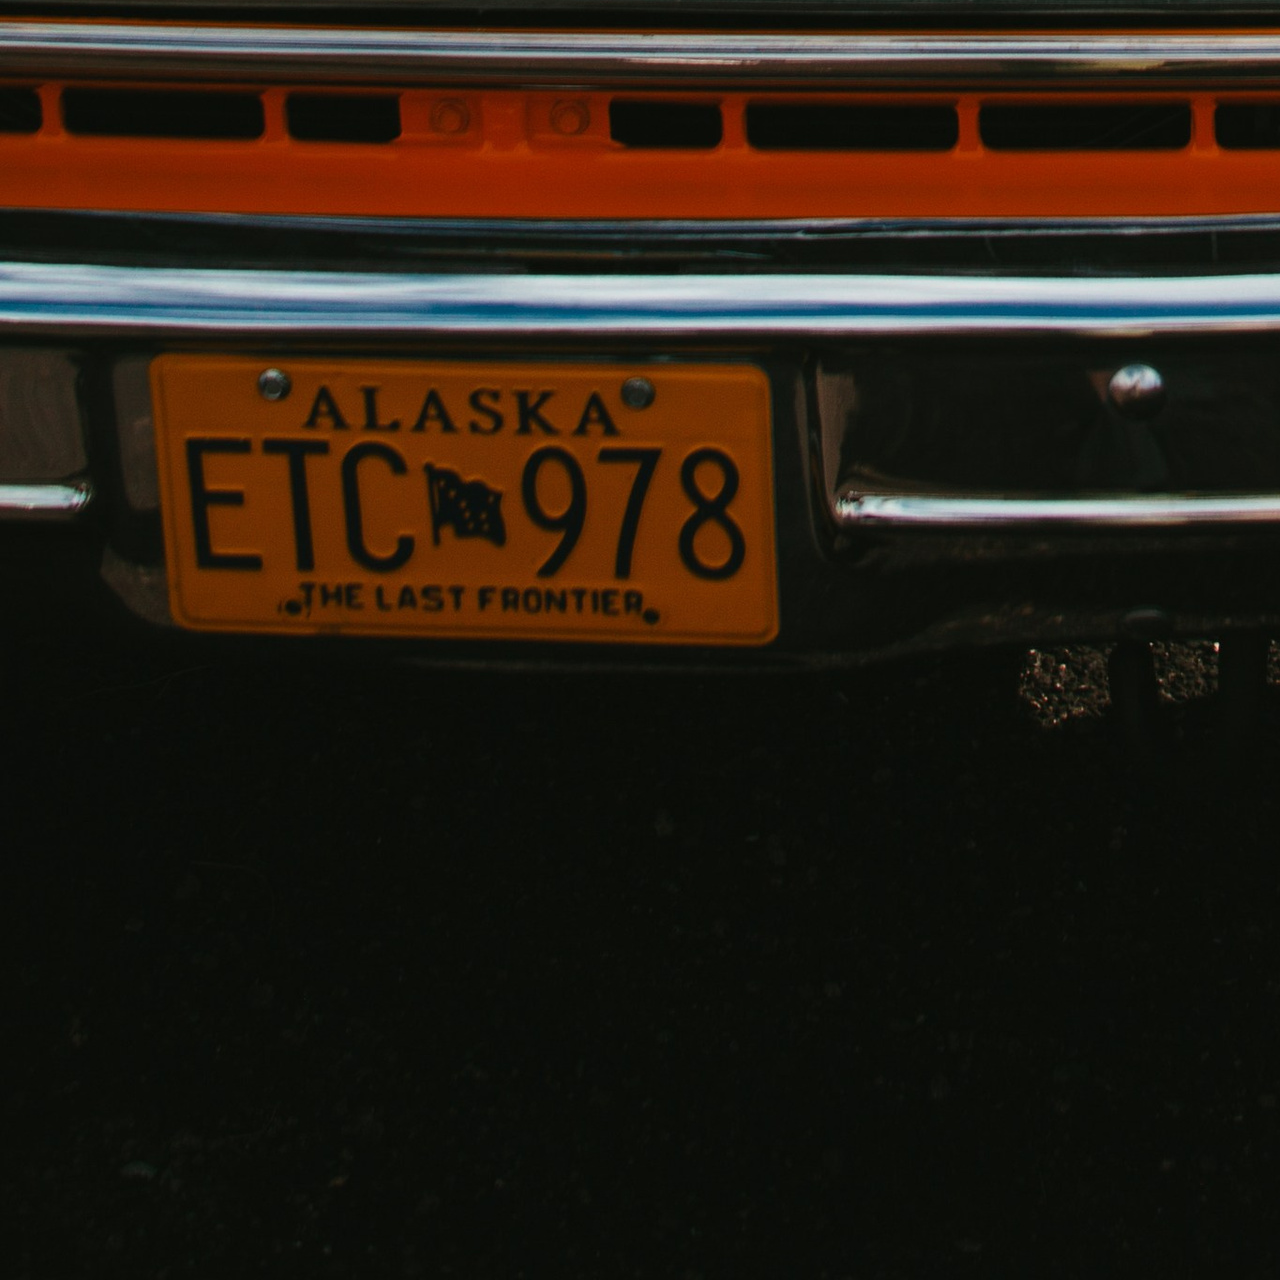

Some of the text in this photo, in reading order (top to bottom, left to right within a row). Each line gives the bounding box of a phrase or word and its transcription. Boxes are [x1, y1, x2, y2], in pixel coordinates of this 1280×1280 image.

[302, 385, 622, 437] ALASKA
[185, 437, 747, 582] ETC 978
[300, 581, 644, 617] THE LAST FRONTIER
